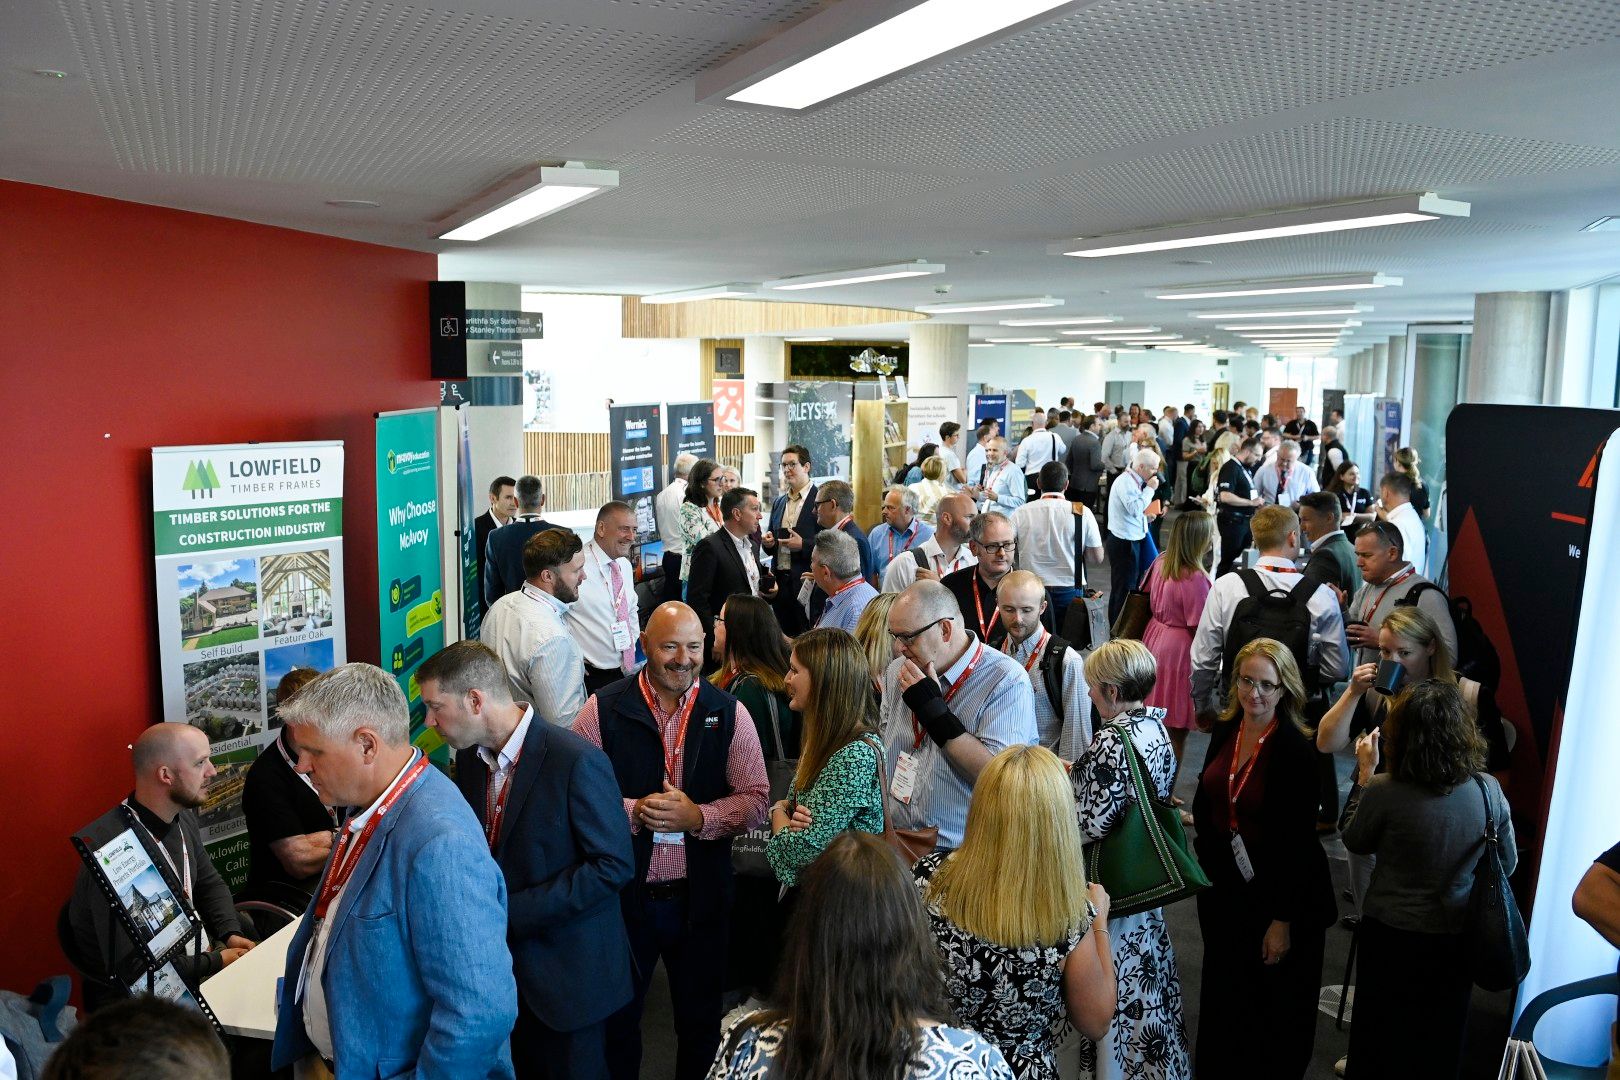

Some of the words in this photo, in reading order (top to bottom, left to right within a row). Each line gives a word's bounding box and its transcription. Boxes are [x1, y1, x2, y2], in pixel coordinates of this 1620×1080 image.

[469, 326, 495, 334] Stanley
[489, 318, 500, 326] Syr
[625, 419, 647, 430] Wernick
[681, 415, 702, 426] Wernick
[229, 457, 321, 478] LOWFIELD
[231, 483, 274, 494] TIMBER
[279, 480, 321, 490] FRAMES
[169, 511, 218, 526] TIMBER
[220, 504, 285, 521] SOLUTIONS
[288, 503, 311, 515] FOR
[311, 502, 331, 513] THE
[388, 506, 406, 527] Why
[406, 499, 436, 519] Choose
[179, 526, 272, 546] CONSTRUCTION
[274, 521, 326, 536] INDUSTRY
[400, 528, 429, 551] McAvoy
[1568, 544, 1581, 558] We
[274, 633, 307, 646] Feature
[309, 630, 324, 640] Oak
[200, 648, 219, 660] Self
[220, 644, 243, 656] Build
[210, 736, 251, 754] esidential
[112, 864, 124, 875] Low
[120, 854, 137, 869] Energy
[112, 871, 131, 887] Projects
[127, 858, 147, 875] Portfolio
[225, 857, 248, 872] Call:
